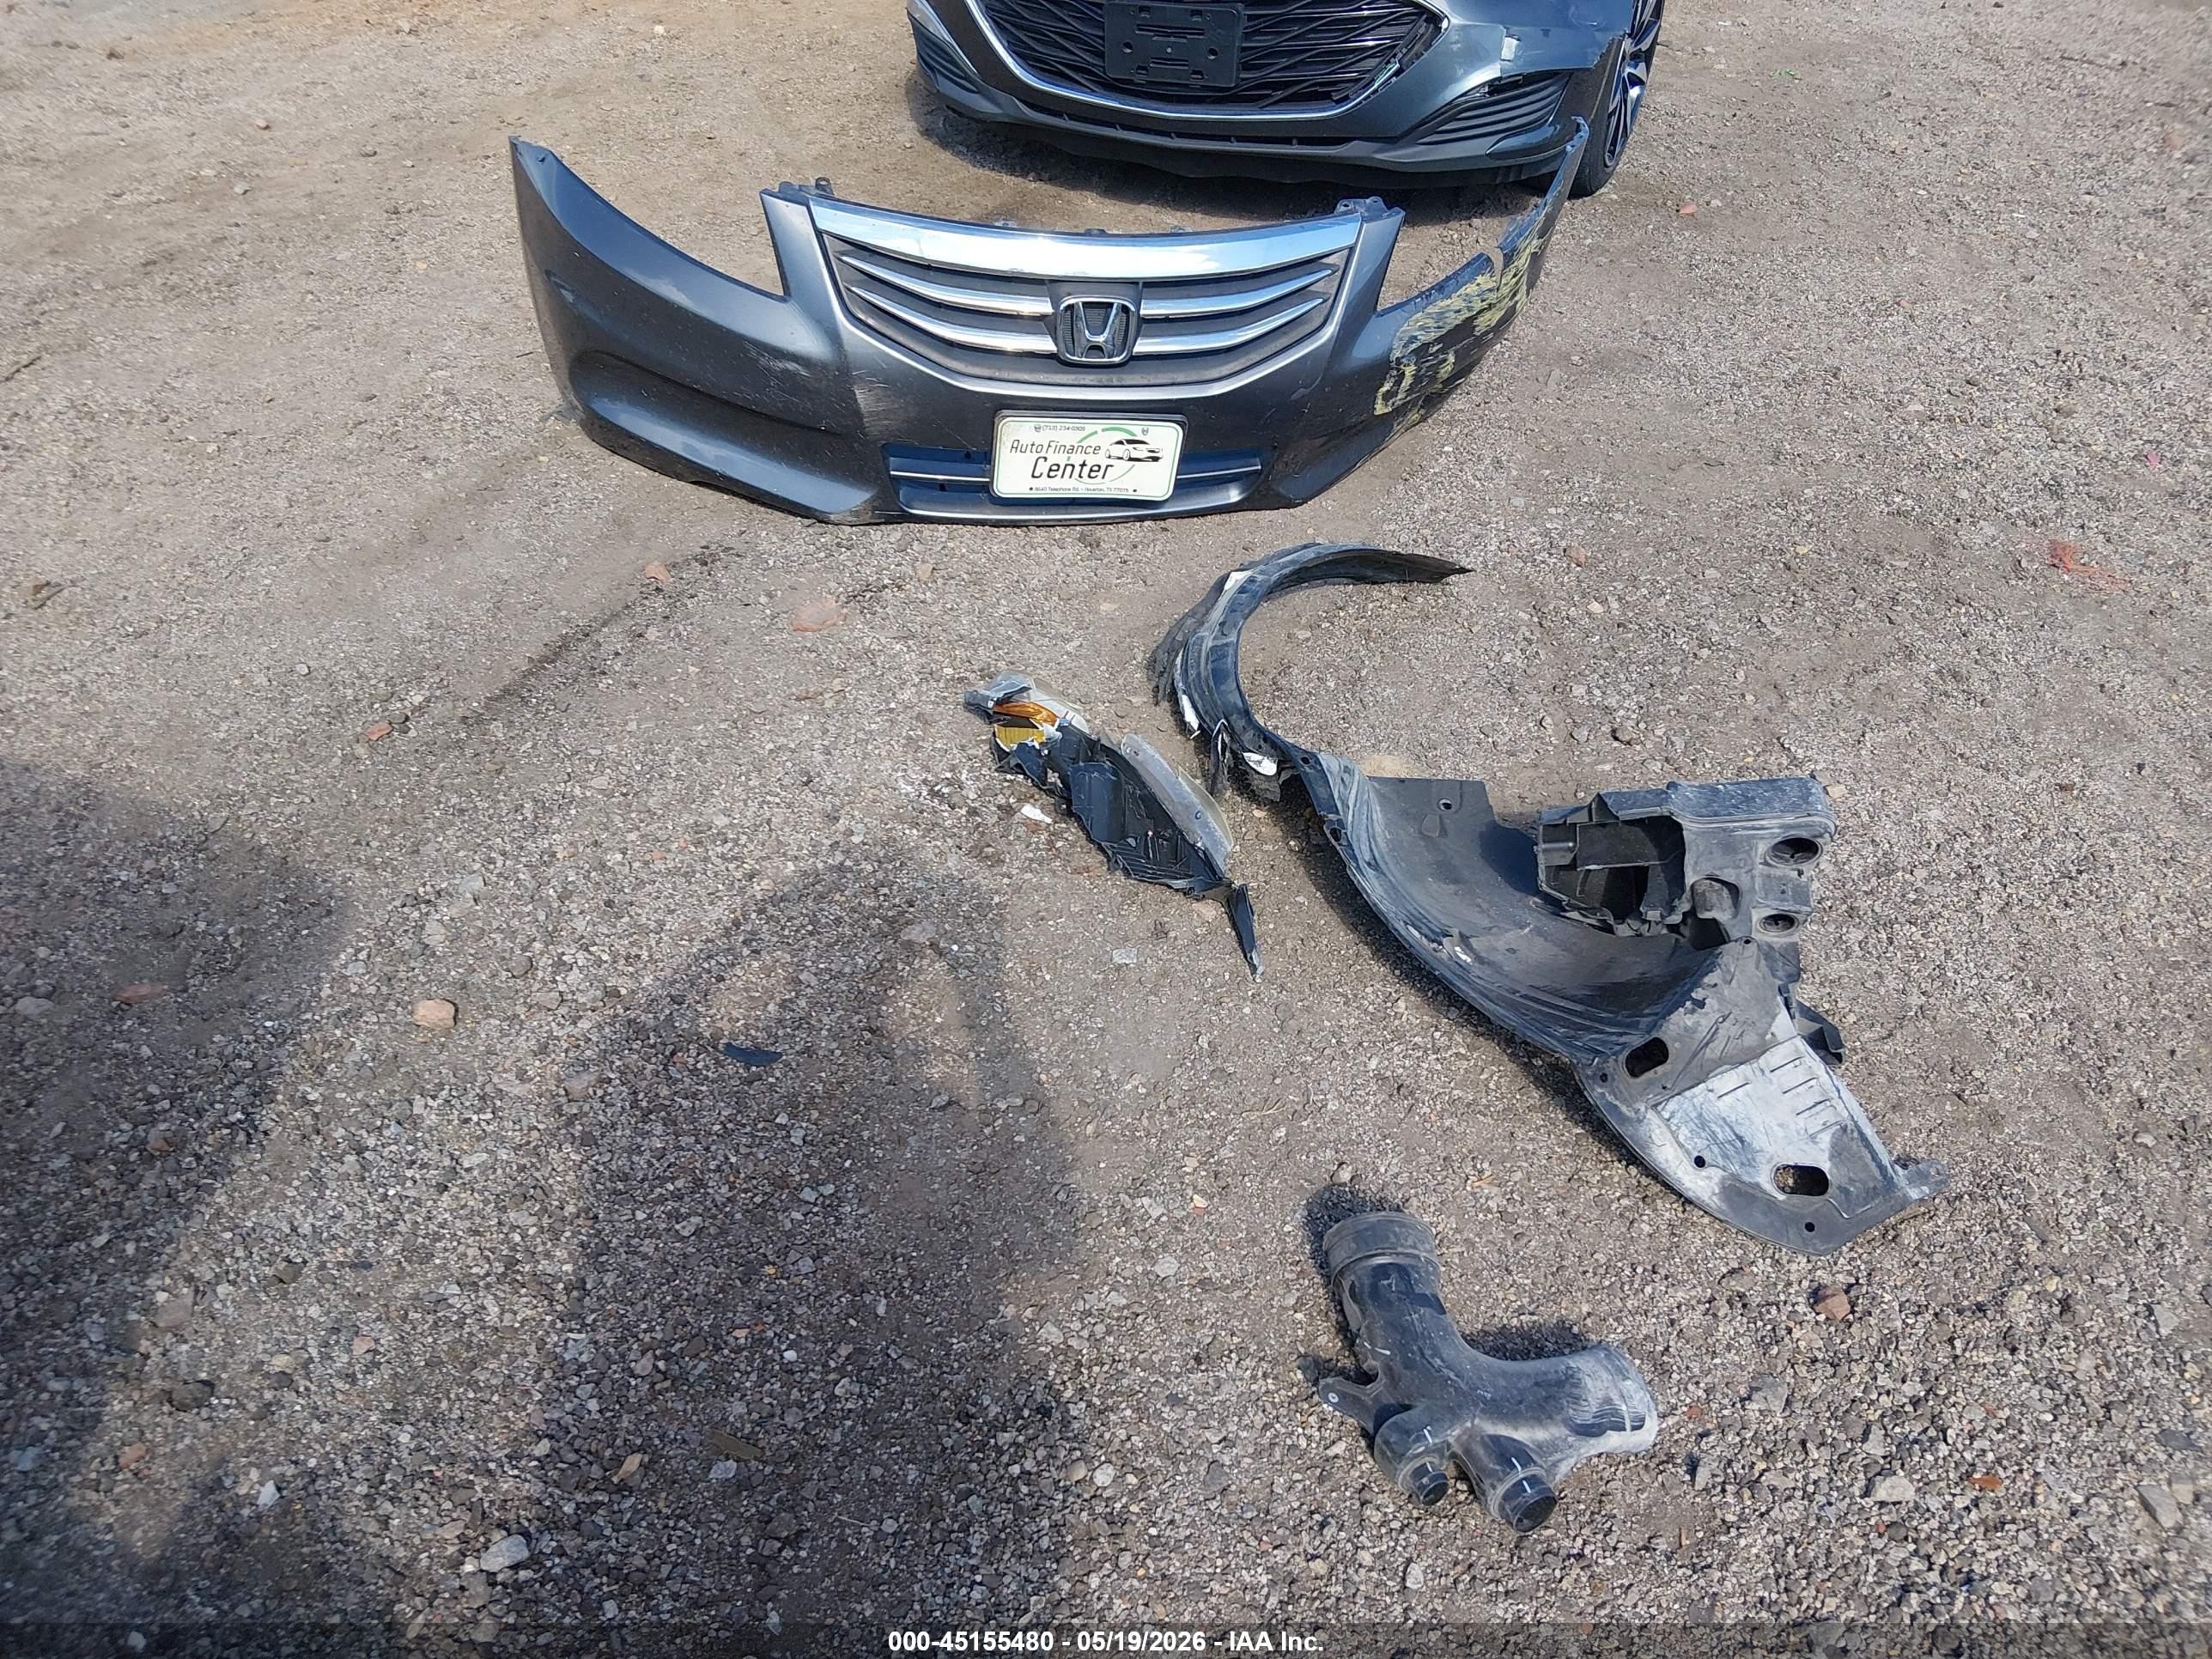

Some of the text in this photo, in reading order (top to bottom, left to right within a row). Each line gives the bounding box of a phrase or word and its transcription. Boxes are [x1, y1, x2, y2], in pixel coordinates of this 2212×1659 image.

[1009, 439, 1102, 455] Auto Finance
[1030, 456, 1115, 480] Center
